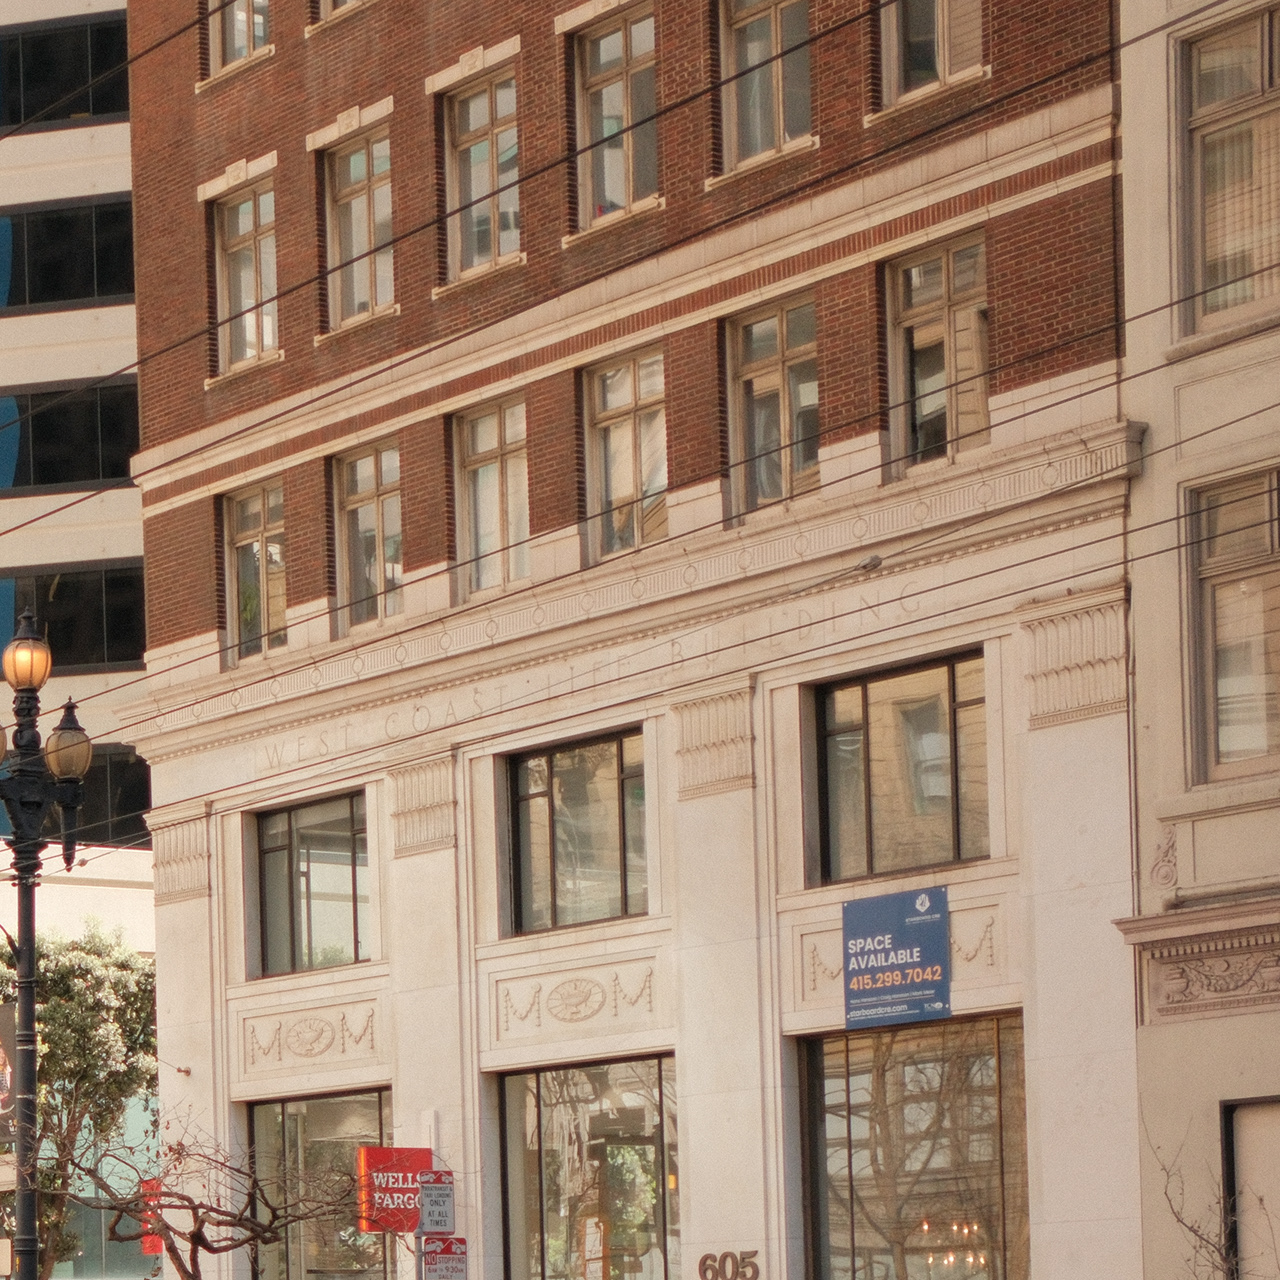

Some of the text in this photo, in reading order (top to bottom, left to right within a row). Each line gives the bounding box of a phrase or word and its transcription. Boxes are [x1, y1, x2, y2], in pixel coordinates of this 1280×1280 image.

[264, 724, 353, 769] WEST
[384, 685, 508, 739] COAST
[848, 935, 892, 953] SPACE
[849, 948, 920, 970] AVAILABLE
[849, 966, 942, 990] 415.299.7042
[426, 1254, 437, 1264] NO
